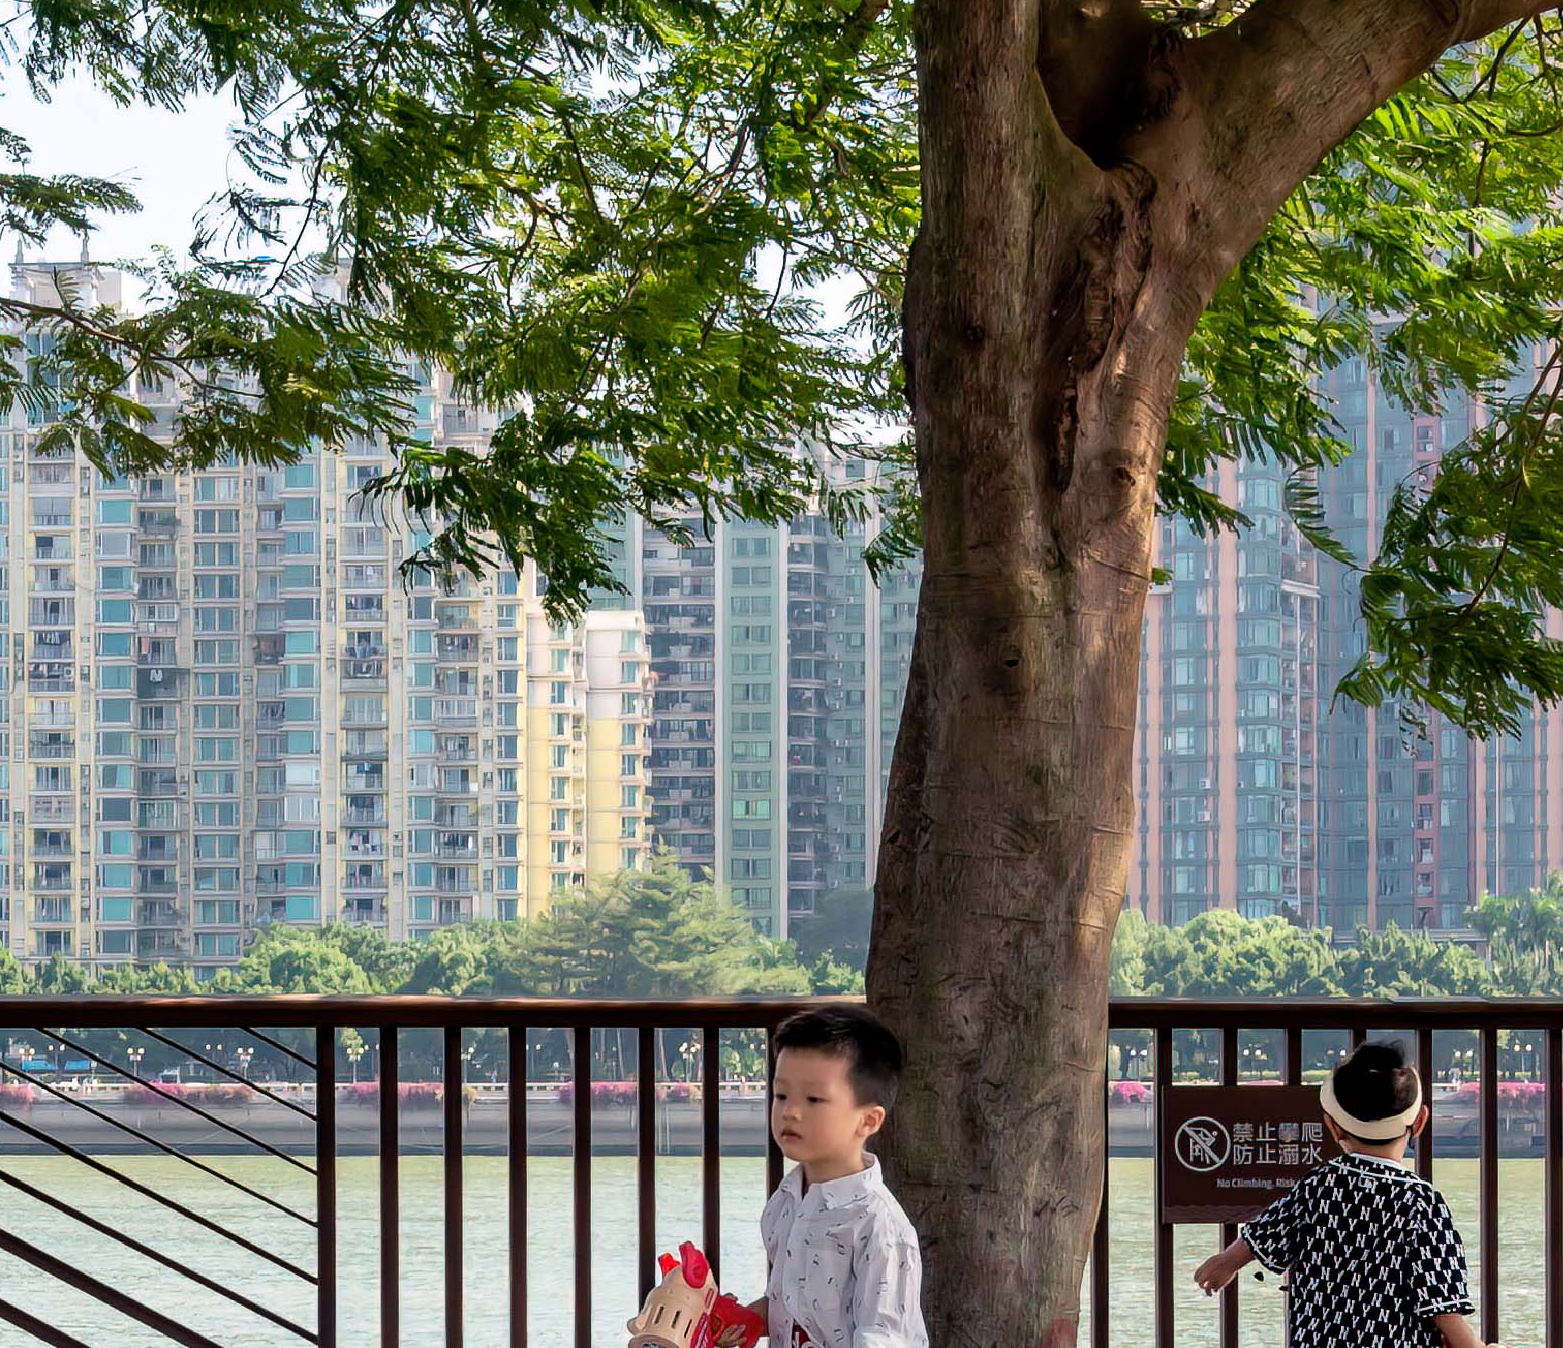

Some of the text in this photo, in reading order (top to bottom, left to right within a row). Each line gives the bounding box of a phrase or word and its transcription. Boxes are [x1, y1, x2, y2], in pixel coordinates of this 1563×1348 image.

[1232, 1121, 1324, 1143] 禁止攀爬
[1232, 1143, 1324, 1165] 防止溺水
